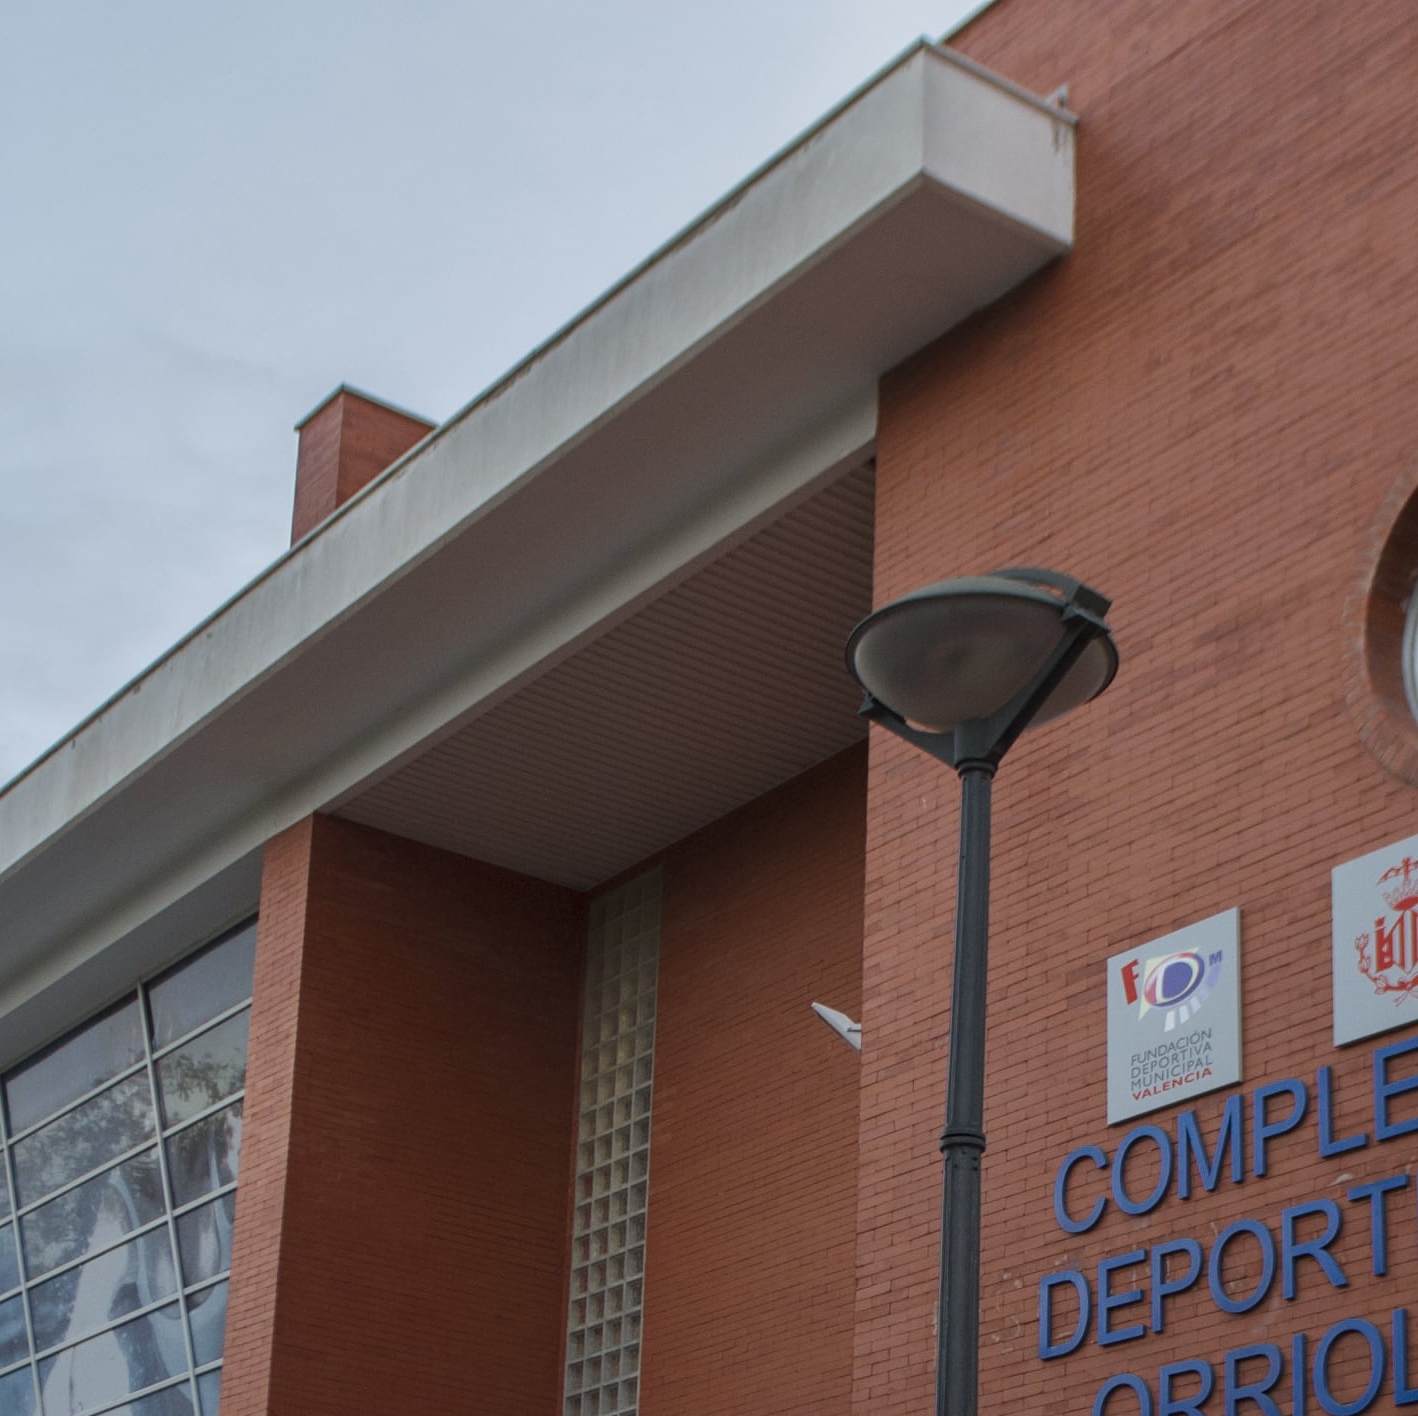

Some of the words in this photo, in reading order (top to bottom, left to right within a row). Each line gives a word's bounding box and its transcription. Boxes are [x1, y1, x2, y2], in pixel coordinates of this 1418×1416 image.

[1131, 1028, 1212, 1067] FUNDACIÓN
[1131, 1041, 1212, 1079] DEPORTIVA
[1131, 1055, 1213, 1091] MUNICIPAL
[1132, 1067, 1213, 1101] VALENCIA
